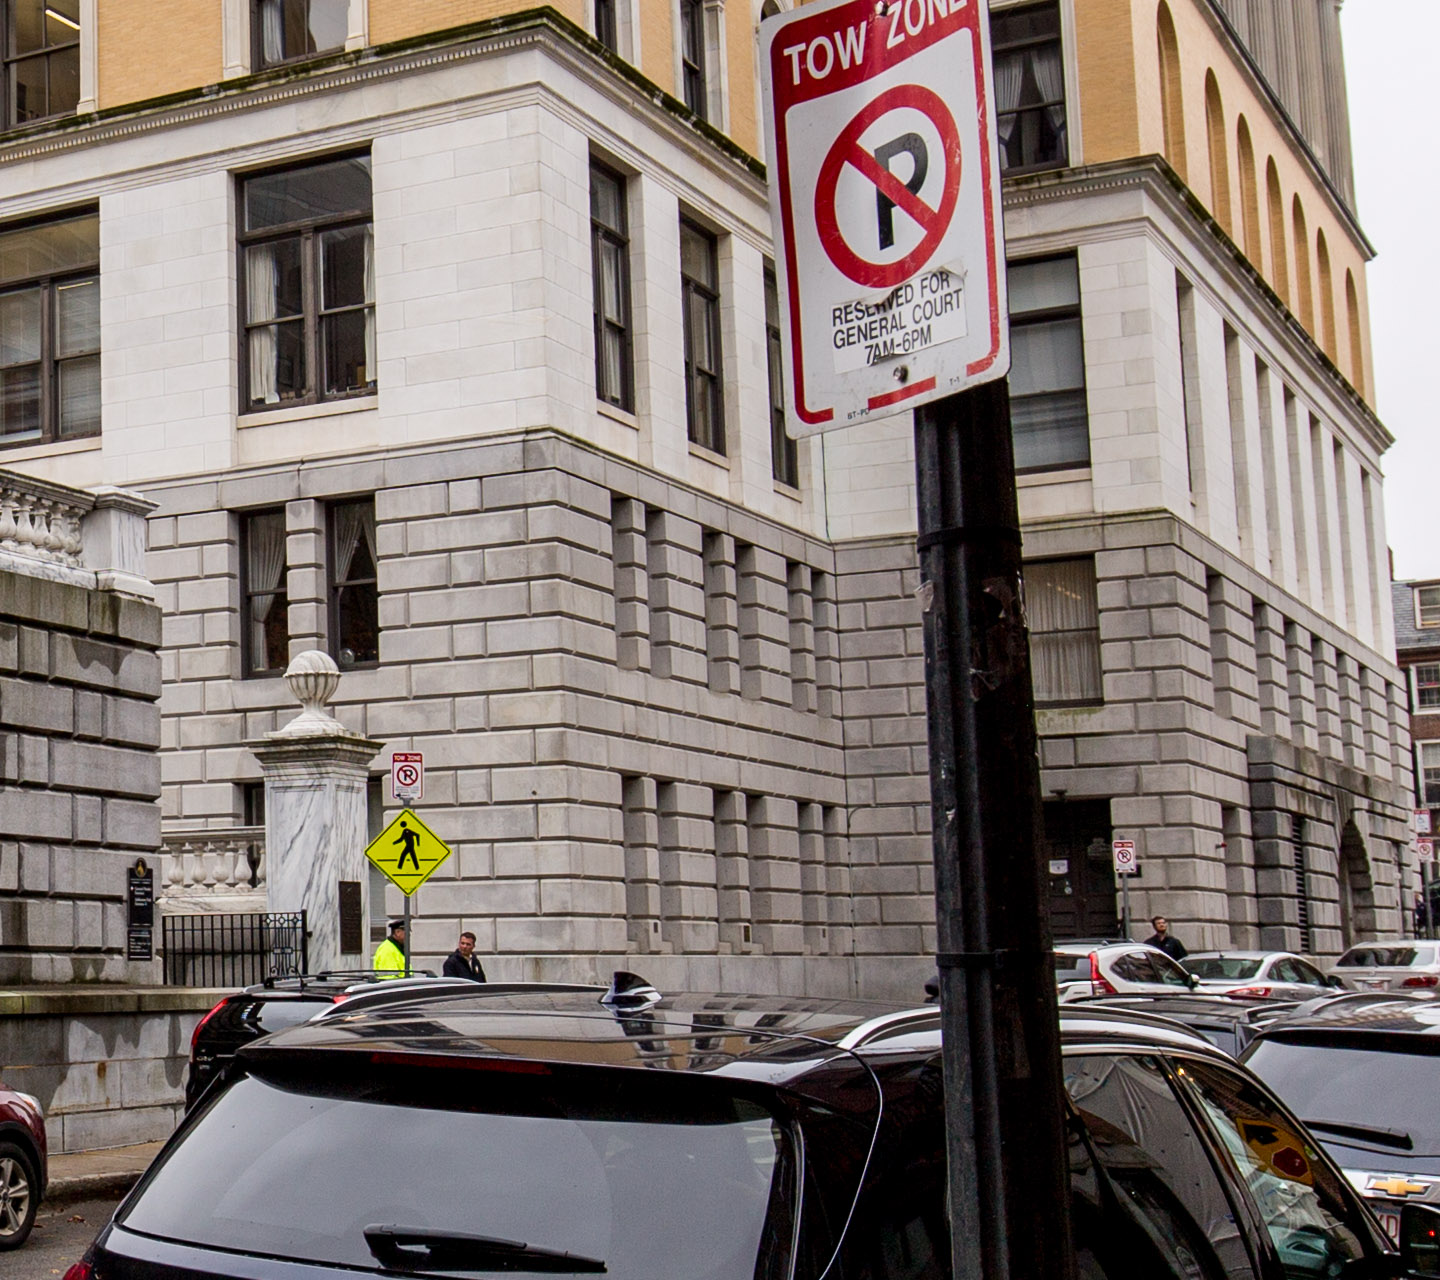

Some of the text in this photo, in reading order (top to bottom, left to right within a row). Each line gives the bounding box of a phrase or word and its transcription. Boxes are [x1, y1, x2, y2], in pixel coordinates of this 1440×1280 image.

[784, 21, 867, 86] TOW
[921, 271, 951, 297] FOR
[833, 288, 962, 349] GENERAL COURT
[865, 324, 932, 365] 7AM-6PM
